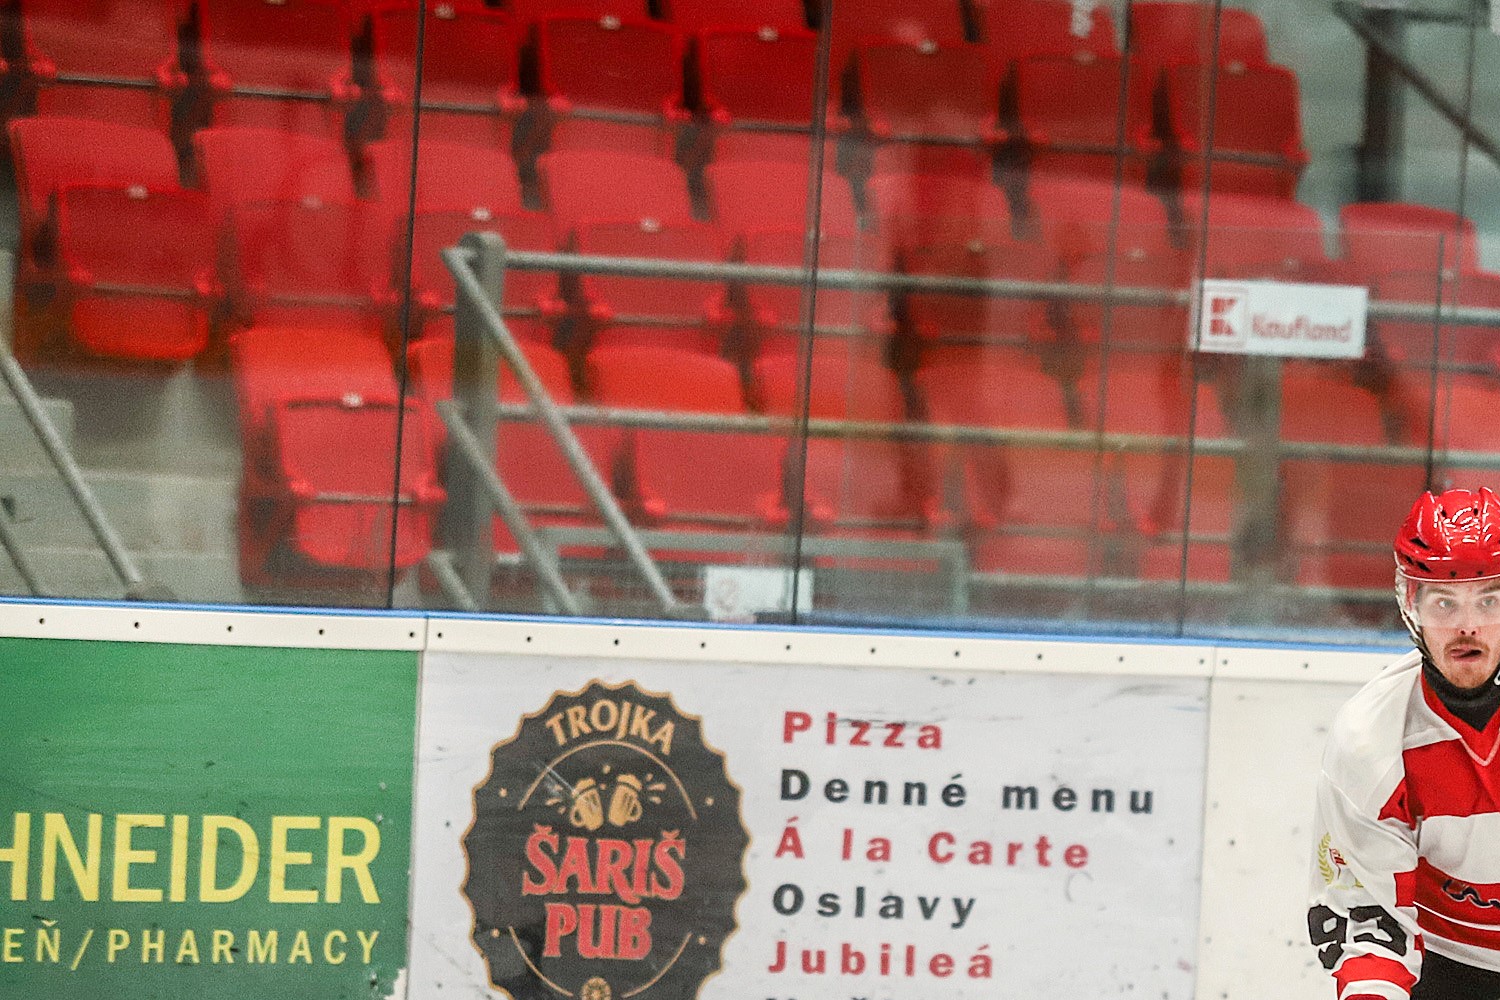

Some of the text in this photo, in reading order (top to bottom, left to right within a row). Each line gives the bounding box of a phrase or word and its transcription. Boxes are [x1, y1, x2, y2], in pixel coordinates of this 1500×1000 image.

[546, 700, 677, 754] TROJKA
[783, 711, 943, 750] Pizza
[780, 769, 1152, 815] Denné menu
[0, 812, 381, 903] HNEIDER
[522, 824, 687, 902] ŠARIŠ
[775, 818, 1089, 869] Á la Carte
[542, 902, 652, 960] PUB
[772, 883, 976, 928] Oslavy
[767, 941, 993, 979] Jubileá
[1308, 903, 1408, 970] 93
